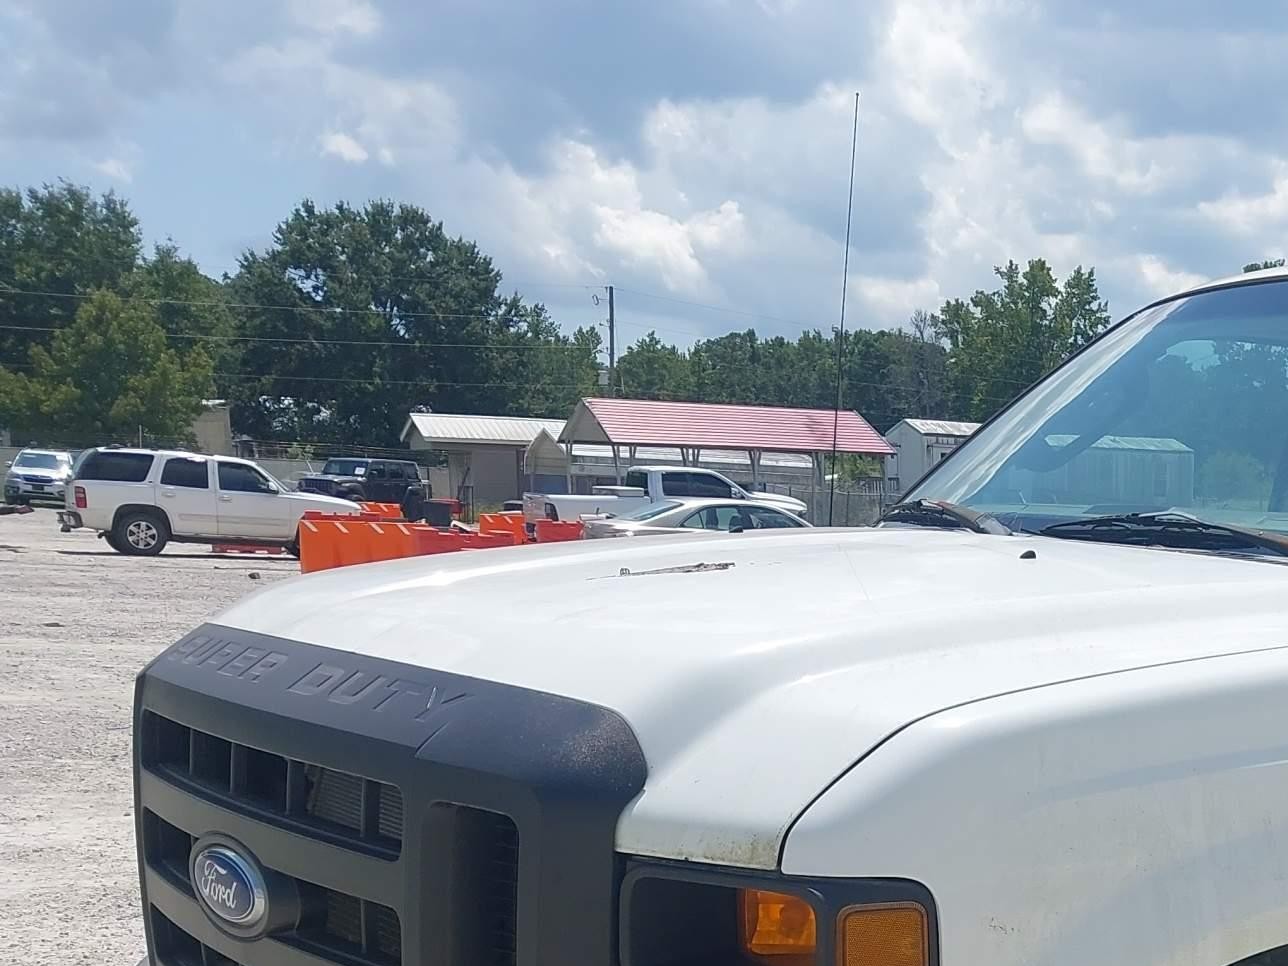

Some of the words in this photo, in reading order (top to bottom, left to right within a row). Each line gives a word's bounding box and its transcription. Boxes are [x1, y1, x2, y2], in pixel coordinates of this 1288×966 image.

[168, 634, 288, 684] SUPER
[286, 661, 475, 722] DUTY
[202, 860, 237, 909] Ford
